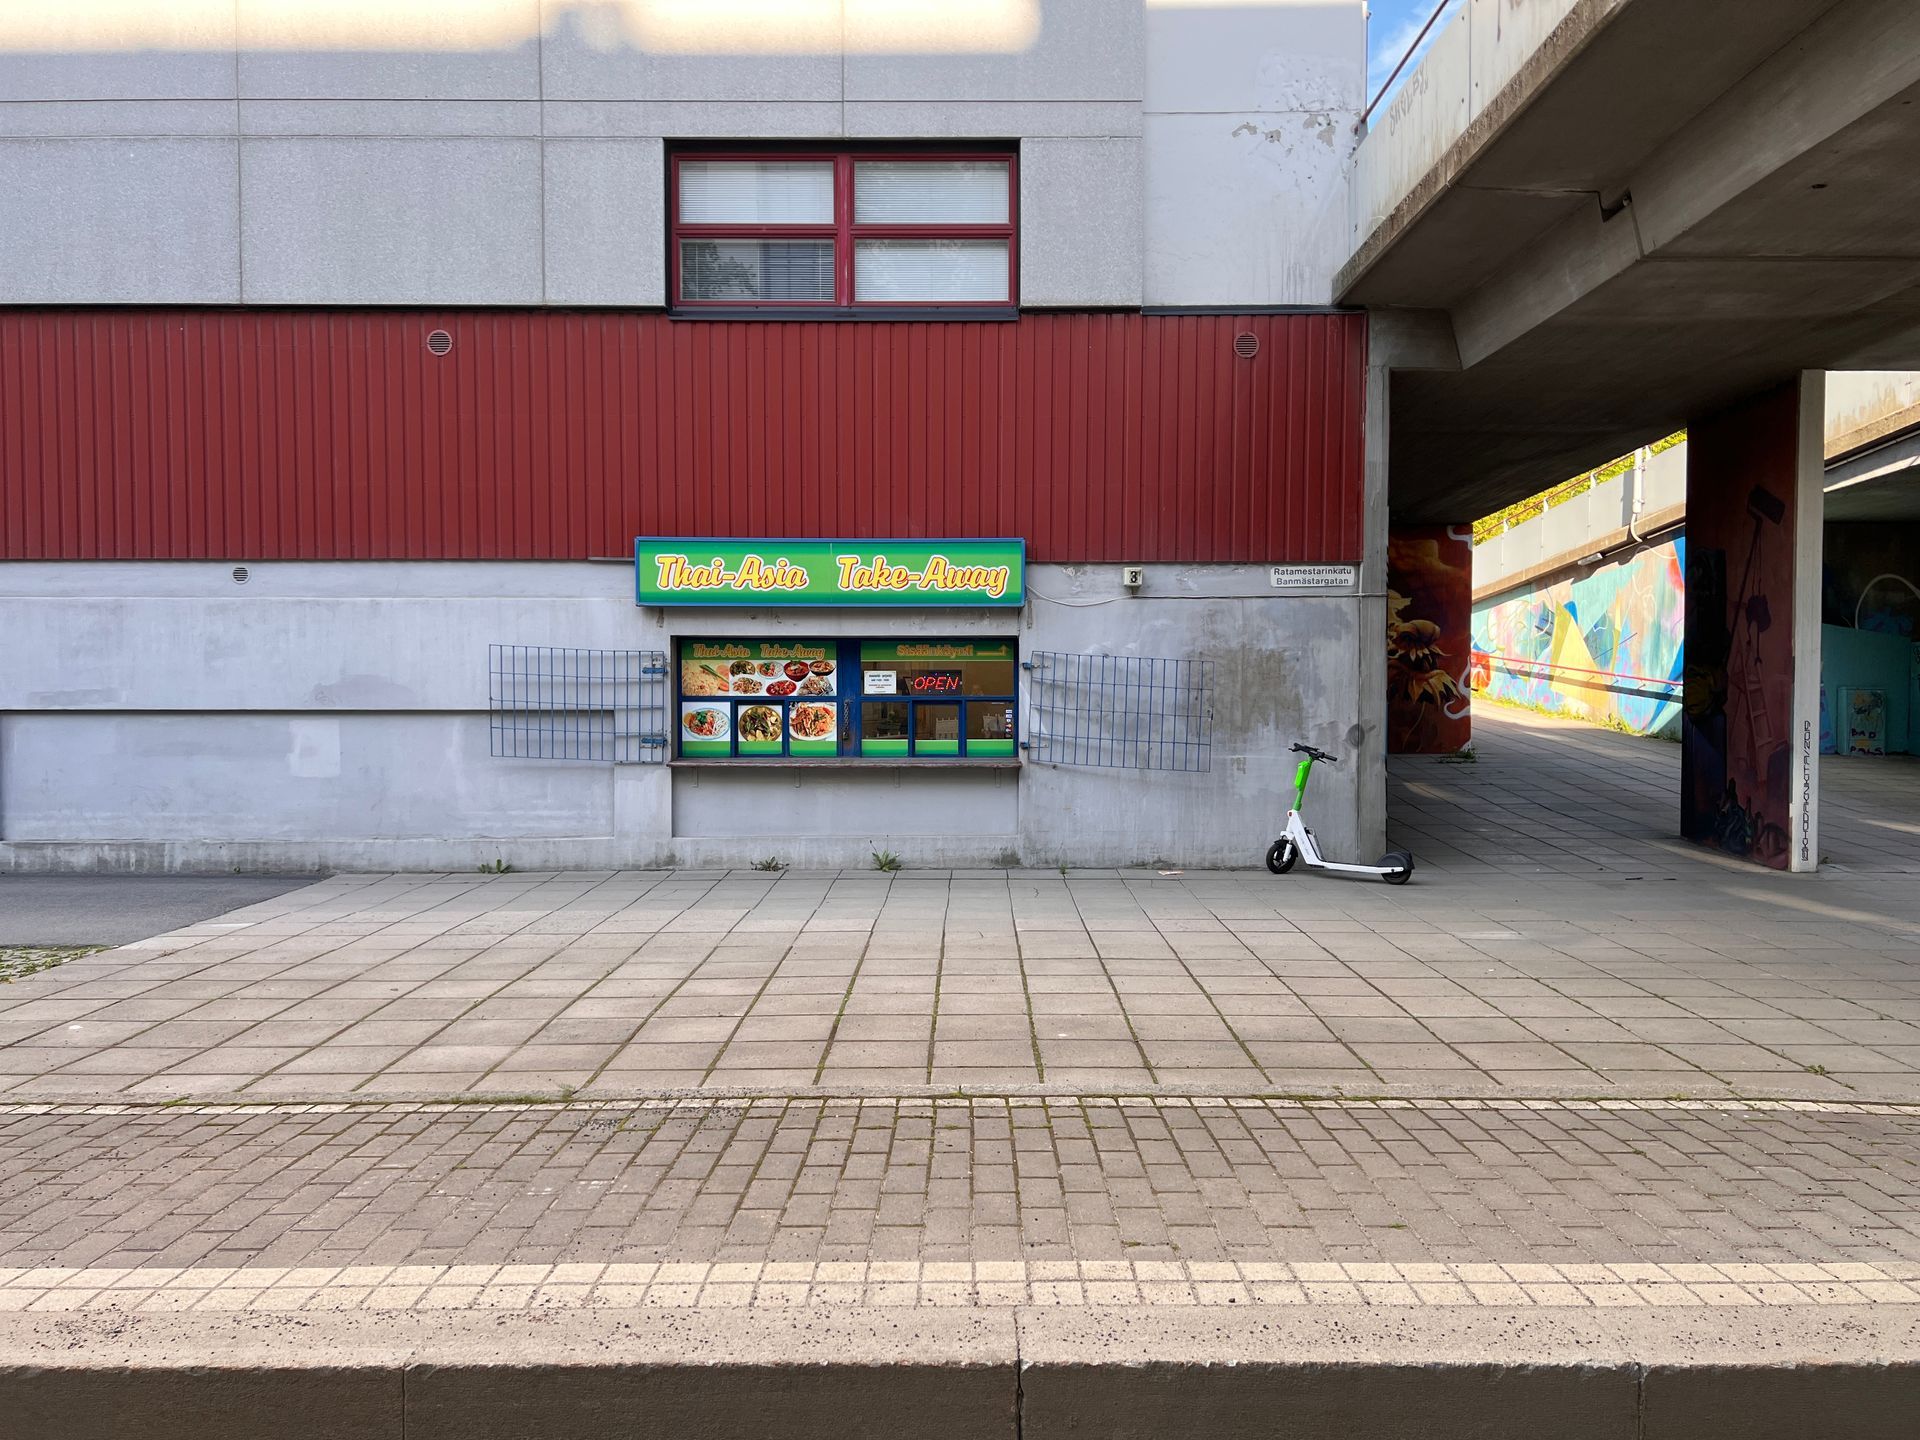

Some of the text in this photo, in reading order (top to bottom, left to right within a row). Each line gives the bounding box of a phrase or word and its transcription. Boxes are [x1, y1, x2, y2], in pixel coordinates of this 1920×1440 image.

[655, 554, 1010, 598] Thai-Asia Take-Away
[1130, 570, 1138, 583] 3
[1273, 567, 1352, 575] Ratamestarinkatu
[1276, 577, 1349, 585] Banmästargatan
[693, 643, 825, 660] Thai-Asia Take-Away
[914, 676, 959, 690] OPEN
